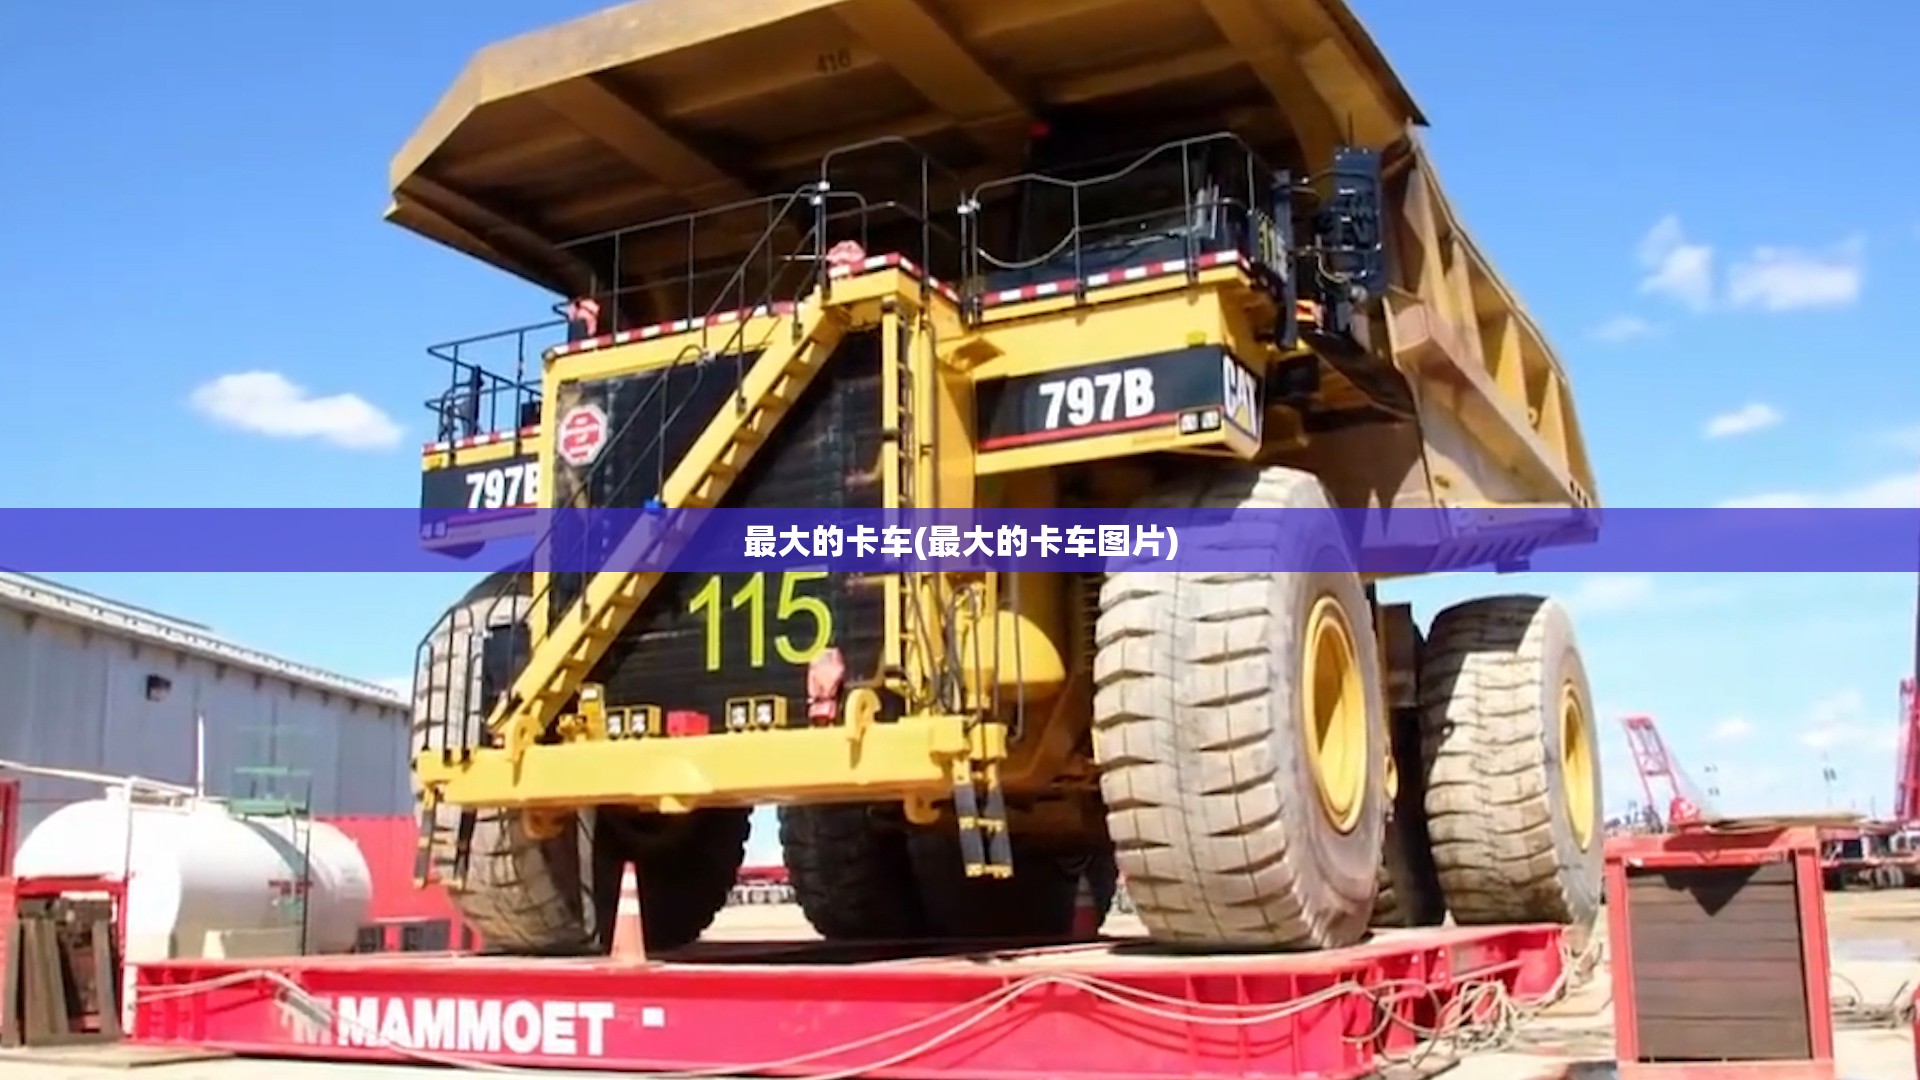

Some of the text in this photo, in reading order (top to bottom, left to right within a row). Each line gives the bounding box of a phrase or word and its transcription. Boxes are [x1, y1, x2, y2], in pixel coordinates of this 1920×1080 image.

[1039, 368, 1155, 429] 797B
[1223, 354, 1257, 436] CAT
[689, 564, 832, 671] 115
[338, 997, 615, 1055] MAMMOET
